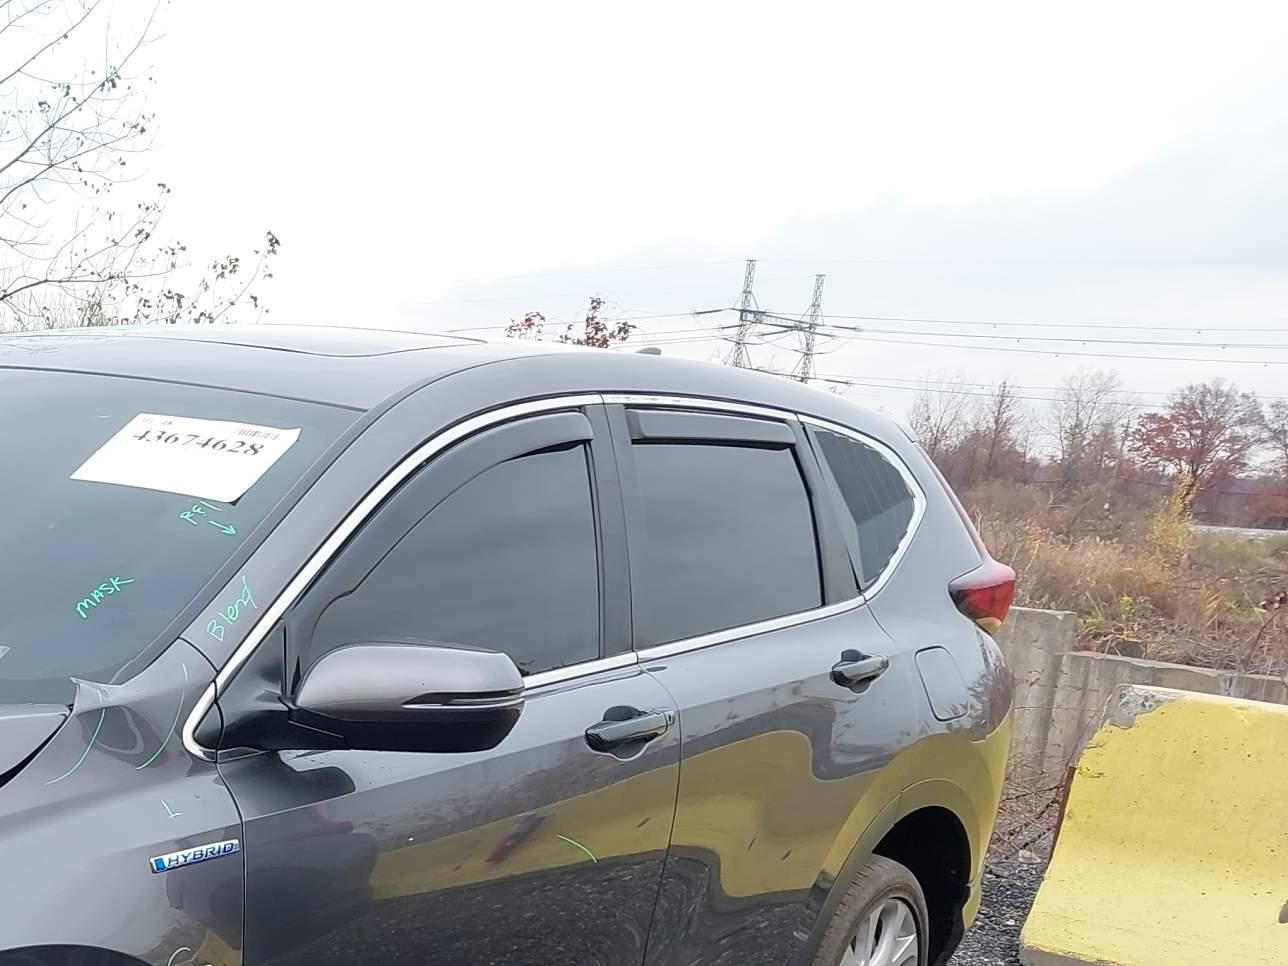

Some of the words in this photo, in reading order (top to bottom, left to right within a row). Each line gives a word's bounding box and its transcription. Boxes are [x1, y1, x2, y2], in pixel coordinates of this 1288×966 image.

[132, 429, 265, 457] 43674628
[206, 575, 258, 643] Blend
[167, 842, 235, 868] HYBRID
